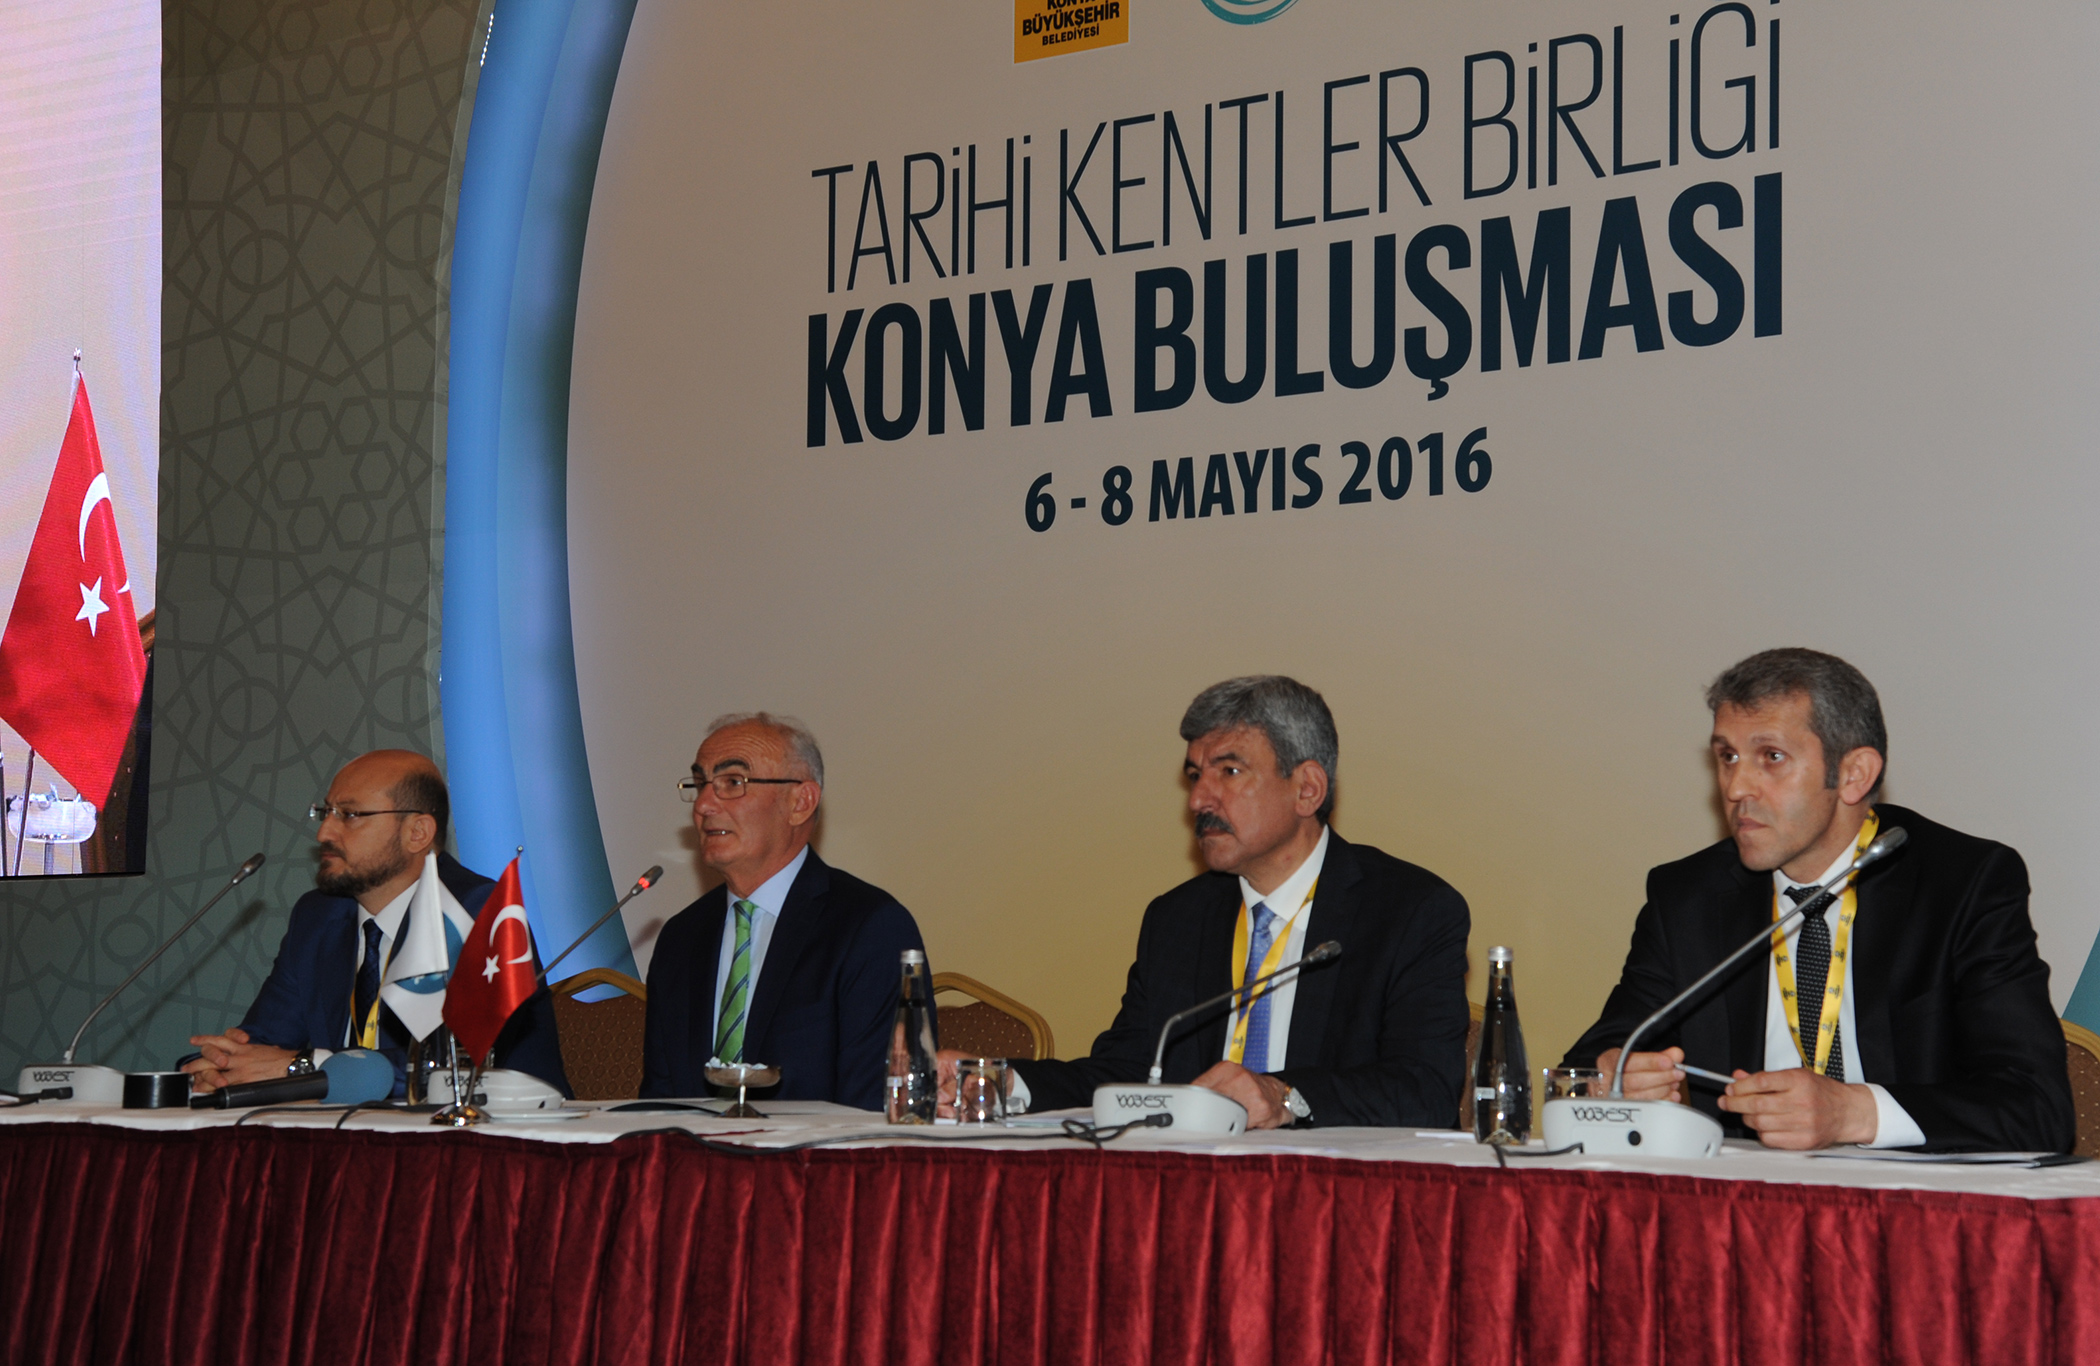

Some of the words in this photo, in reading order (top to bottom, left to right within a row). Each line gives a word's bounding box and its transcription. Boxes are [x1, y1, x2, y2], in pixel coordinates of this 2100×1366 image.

[1022, 0, 1120, 36] BÜYÜKŞEHİR
[1041, 22, 1100, 46] BELEDİYESİ
[811, 134, 1031, 294] TARİHİ
[1059, 66, 1433, 262] KENTLER
[806, 277, 1113, 448] KONYA
[1134, 171, 1783, 414] BULUŞMASI
[1024, 472, 1057, 533] 6
[1070, 497, 1087, 509] -
[1100, 465, 1134, 526] 8
[1148, 443, 1324, 523] MAYIS
[1338, 426, 1493, 505] 2016
